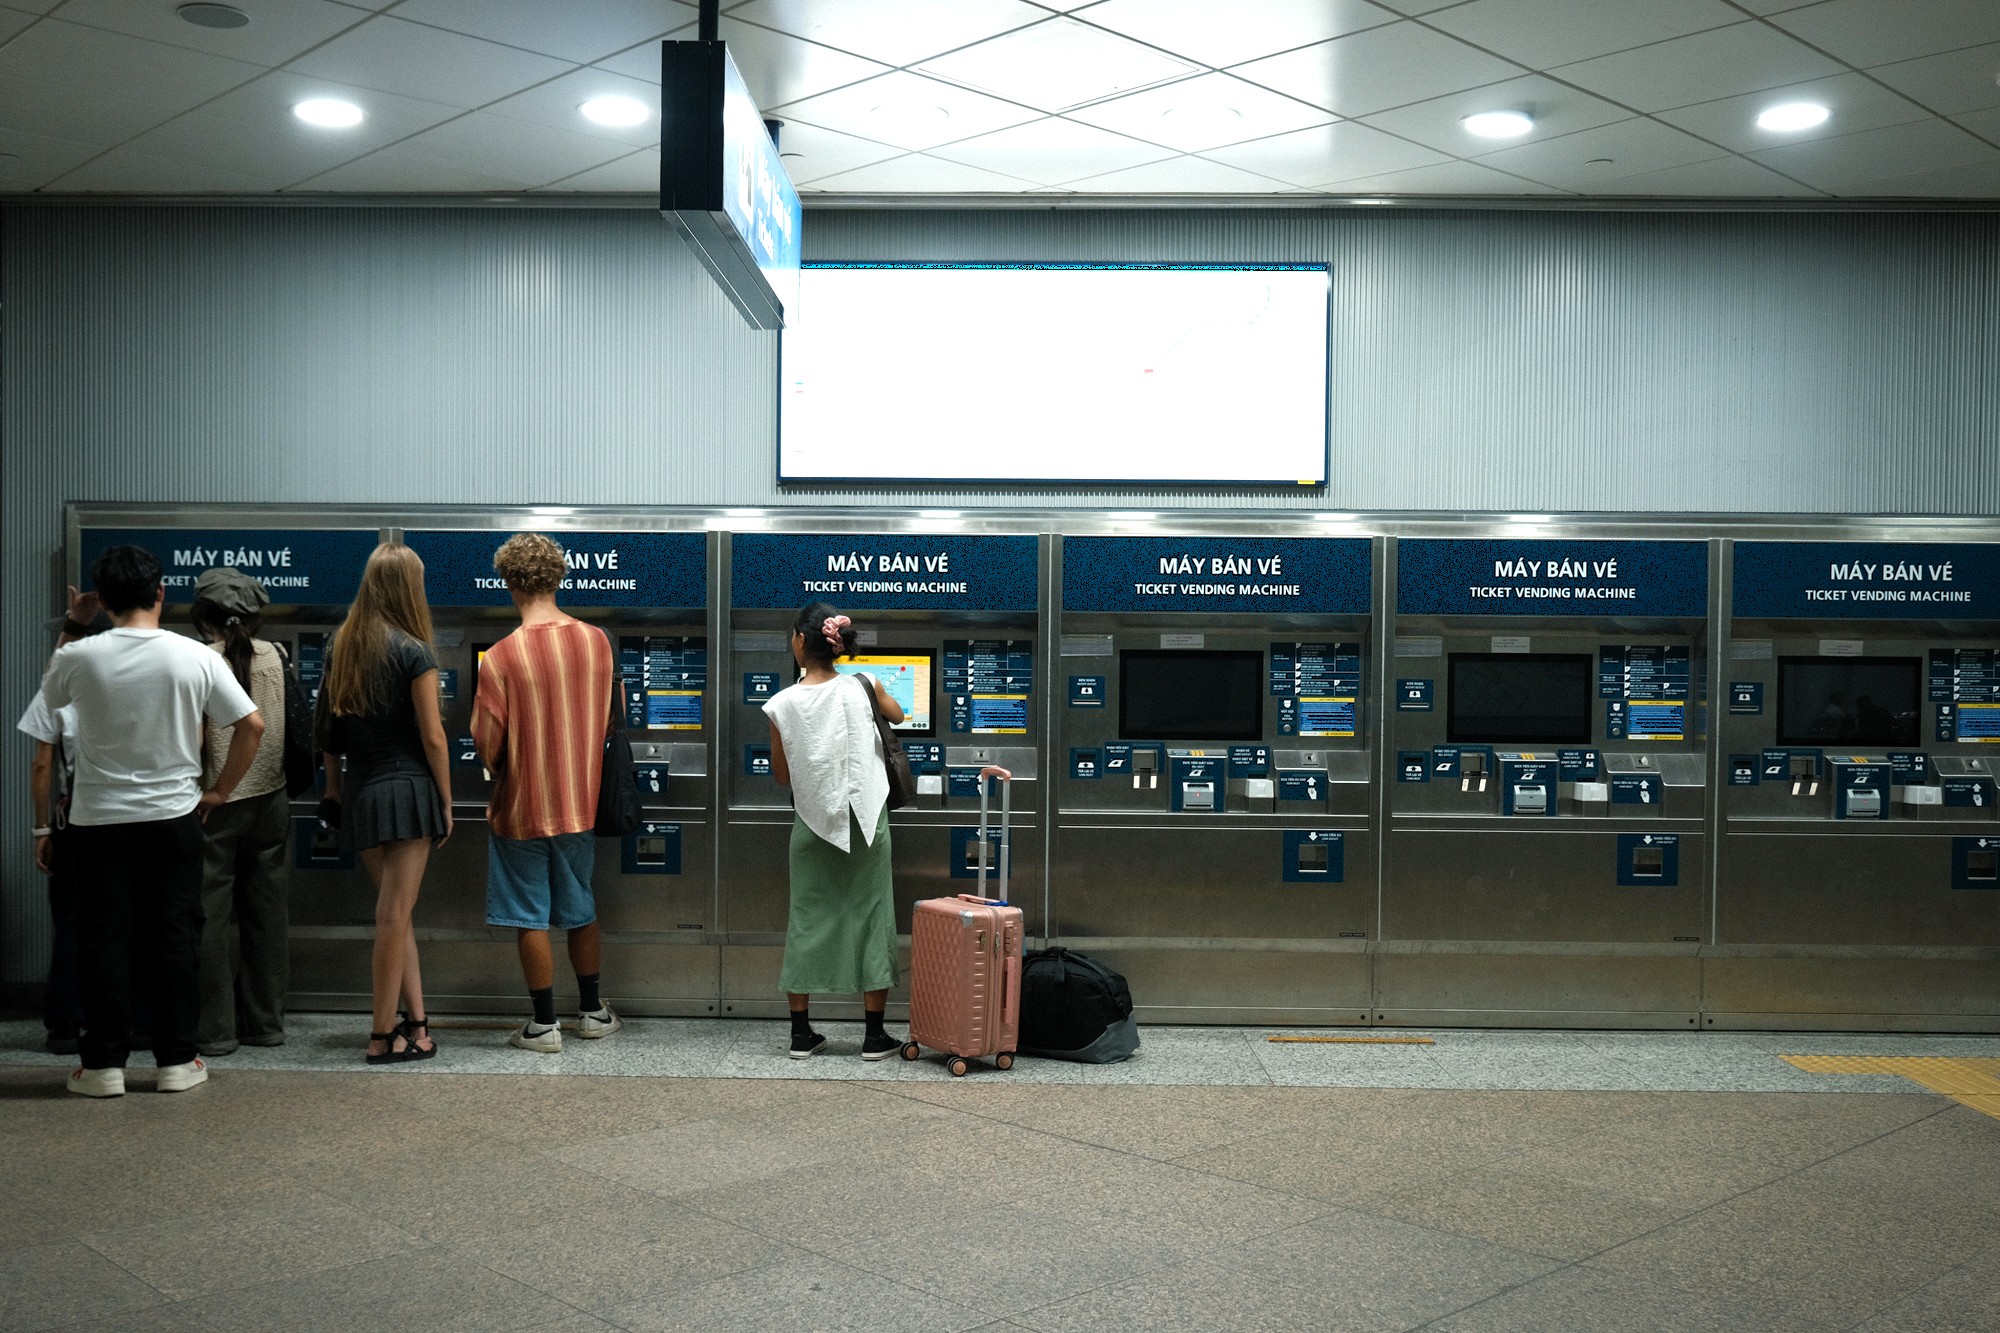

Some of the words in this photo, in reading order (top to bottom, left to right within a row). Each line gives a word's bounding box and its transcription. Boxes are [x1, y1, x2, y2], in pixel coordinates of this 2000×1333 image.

[174, 547, 217, 567] MÁY
[223, 547, 262, 567] BÁN
[267, 548, 291, 567] VÉ
[563, 549, 589, 570] ÁN
[593, 550, 619, 570] VÉ
[827, 552, 873, 572] MÁY
[879, 552, 918, 573] BÁN
[923, 553, 949, 573] VÉ
[1159, 554, 1205, 575] MÁY
[1211, 554, 1251, 575] BÁN
[1257, 554, 1282, 575] VÉ
[1494, 557, 1541, 578] MÁY
[1547, 558, 1588, 578] BÁN
[1592, 558, 1618, 579] VÉ
[1830, 561, 1876, 581] MÁY
[1882, 561, 1922, 581] BÁN
[1928, 561, 1953, 581] VÉ
[160, 575, 191, 586] CKET
[474, 578, 509, 589] TICKE
[576, 579, 637, 590] MACHINE
[803, 581, 844, 592] TICKET
[848, 582, 903, 593] VENDING
[906, 582, 967, 593] MACHINE
[1135, 584, 1177, 595] TICKET
[1179, 584, 1235, 595] VENDING
[1239, 585, 1300, 596] MACHINE
[1469, 587, 1512, 598] TICKET
[1516, 588, 1571, 599] VENDING
[1575, 588, 1636, 599] MACHINE
[1804, 590, 1847, 601] TICKET
[1851, 591, 1906, 602] VENDING
[1910, 591, 1971, 602] MACHINE
